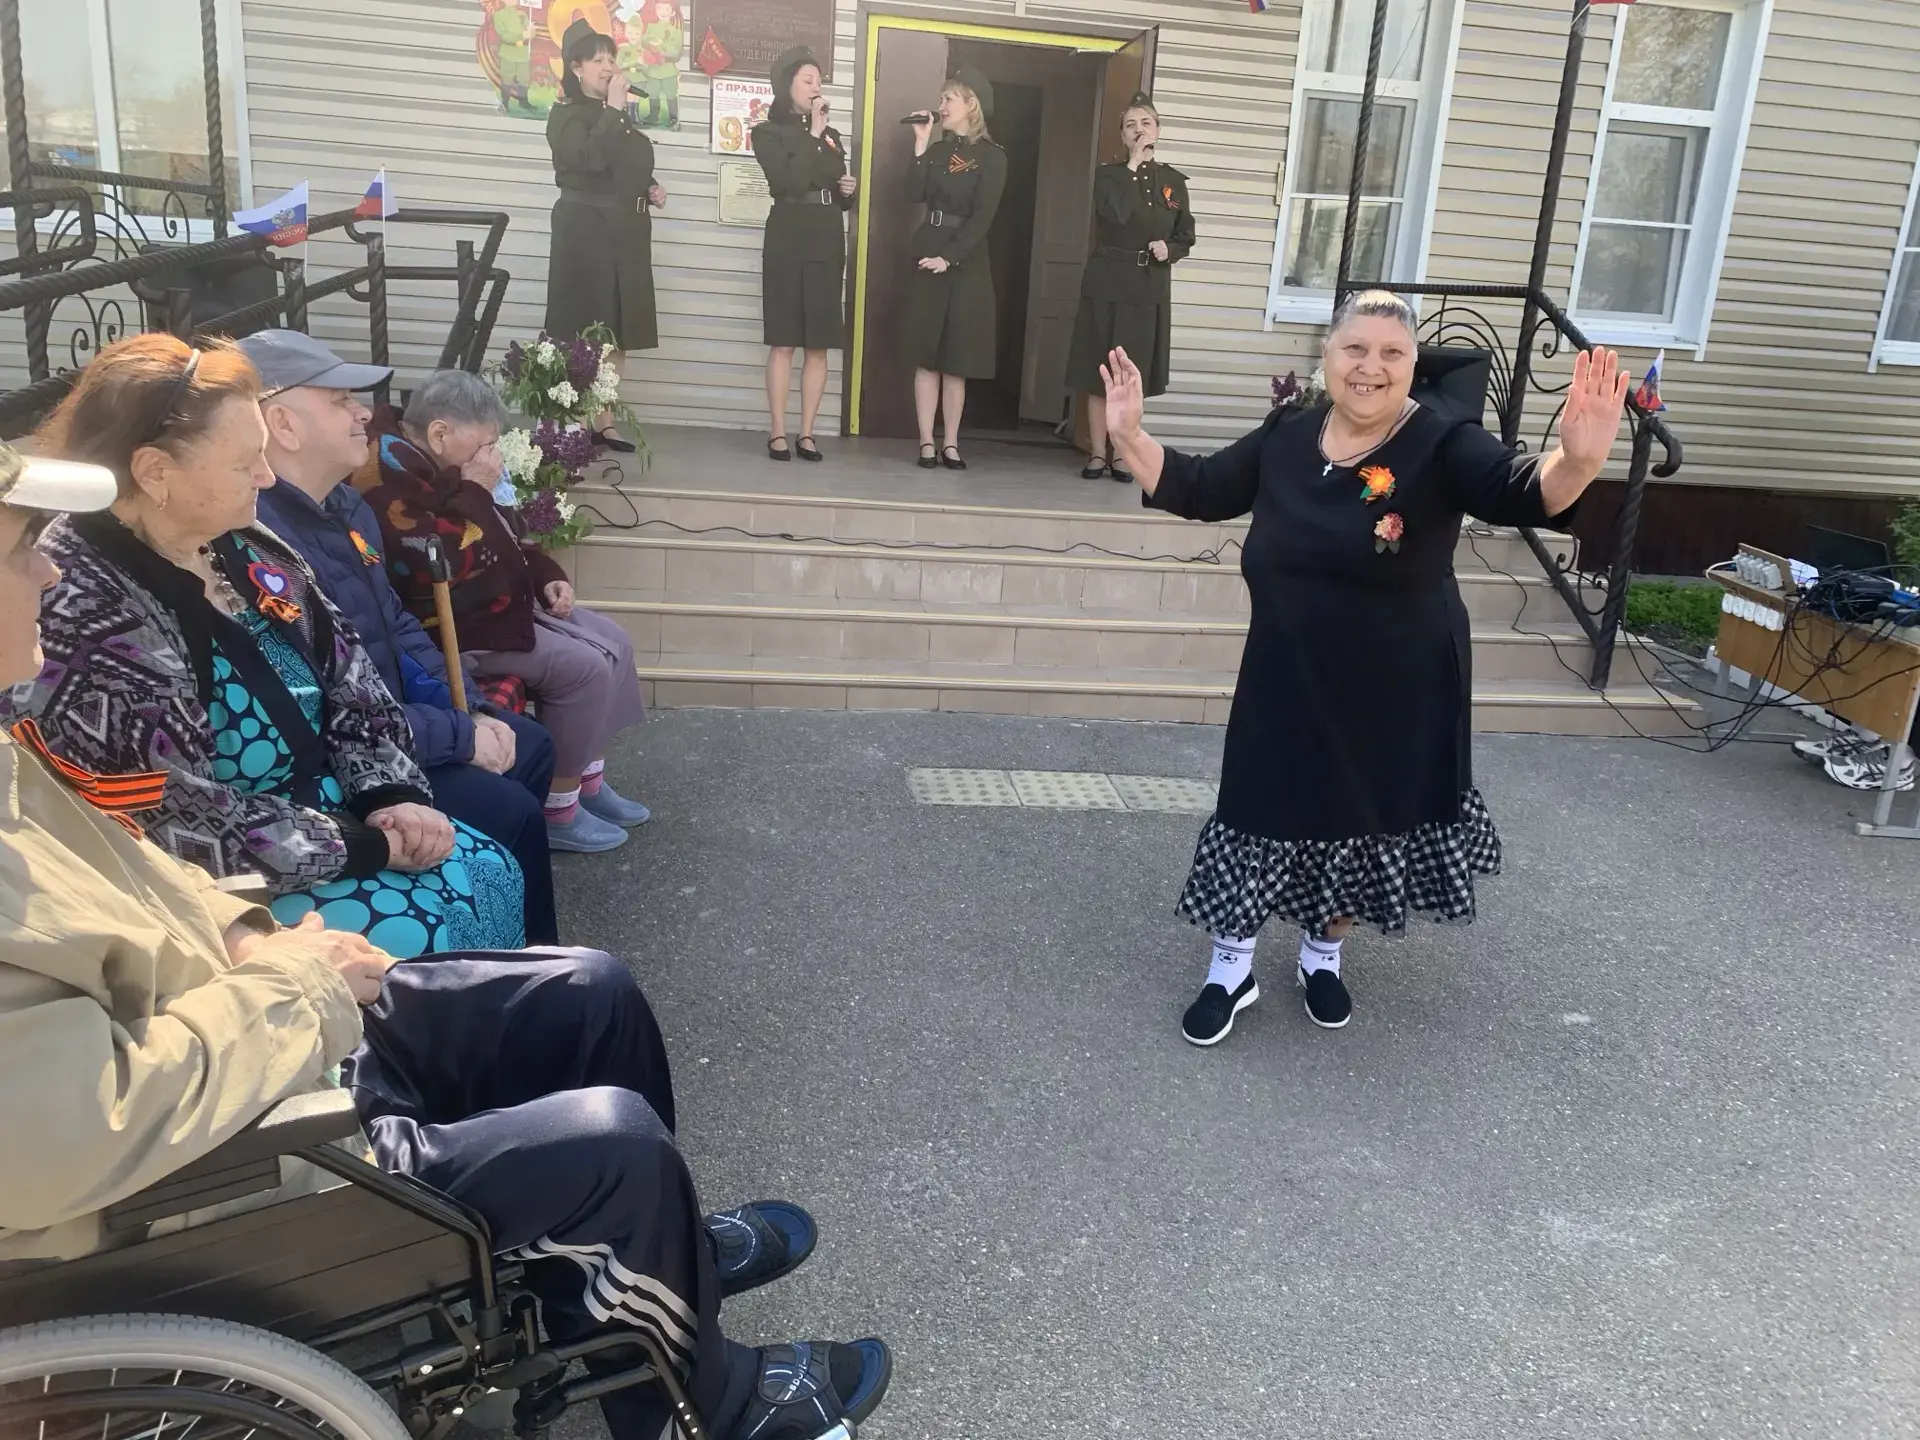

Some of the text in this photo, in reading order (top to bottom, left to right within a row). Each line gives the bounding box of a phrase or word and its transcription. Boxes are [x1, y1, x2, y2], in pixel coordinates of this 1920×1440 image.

[733, 49, 781, 62] ОТДЕЛЕН
[716, 82, 771, 96] С ПРАЗДН
